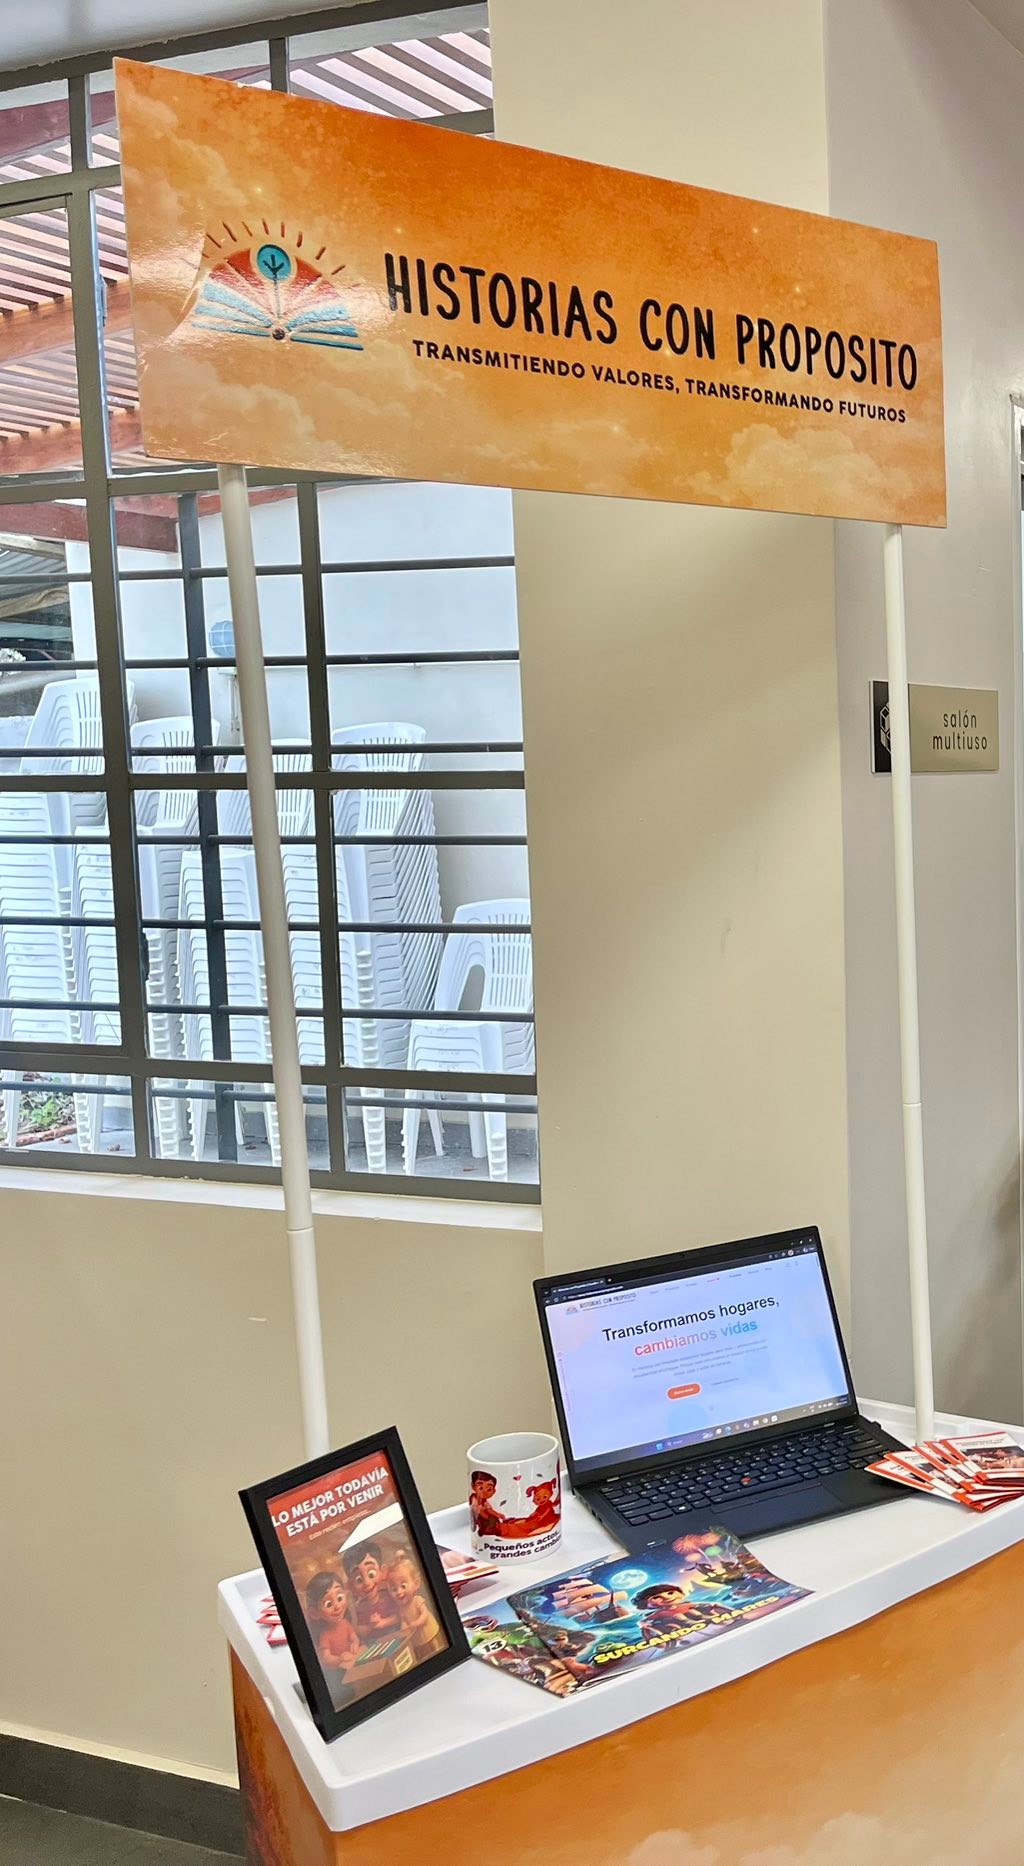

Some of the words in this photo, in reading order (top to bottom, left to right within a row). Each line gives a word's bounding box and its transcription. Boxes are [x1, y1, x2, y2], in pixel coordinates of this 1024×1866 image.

[385, 252, 618, 345] HISTORIAS
[639, 298, 716, 360] CON
[736, 313, 918, 391] PROPOSITO
[412, 339, 585, 378] TRANSMITIENDO
[591, 366, 681, 394] VALORES,
[685, 378, 834, 413] TRANSFORMANDO
[839, 400, 906, 423] FUTUROS
[943, 709, 977, 728] salón
[932, 731, 988, 750] multiuso
[602, 1309, 716, 1342] Transformamos
[719, 1296, 780, 1317] hogares,
[633, 1329, 717, 1356] cambiamos
[720, 1319, 758, 1338] vidas
[271, 1511, 289, 1528] LO
[291, 1491, 335, 1519] MEJOR
[335, 1466, 389, 1498] TODAVÍA
[285, 1511, 319, 1537] ESTÁ
[320, 1501, 347, 1521] POR
[346, 1484, 384, 1508] VENIR
[483, 1542, 535, 1552] Pequeños
[489, 1549, 532, 1559] grandes
[483, 1640, 504, 1653] 13
[594, 1621, 707, 1664] SURCANDO
[711, 1595, 780, 1624] MARES
